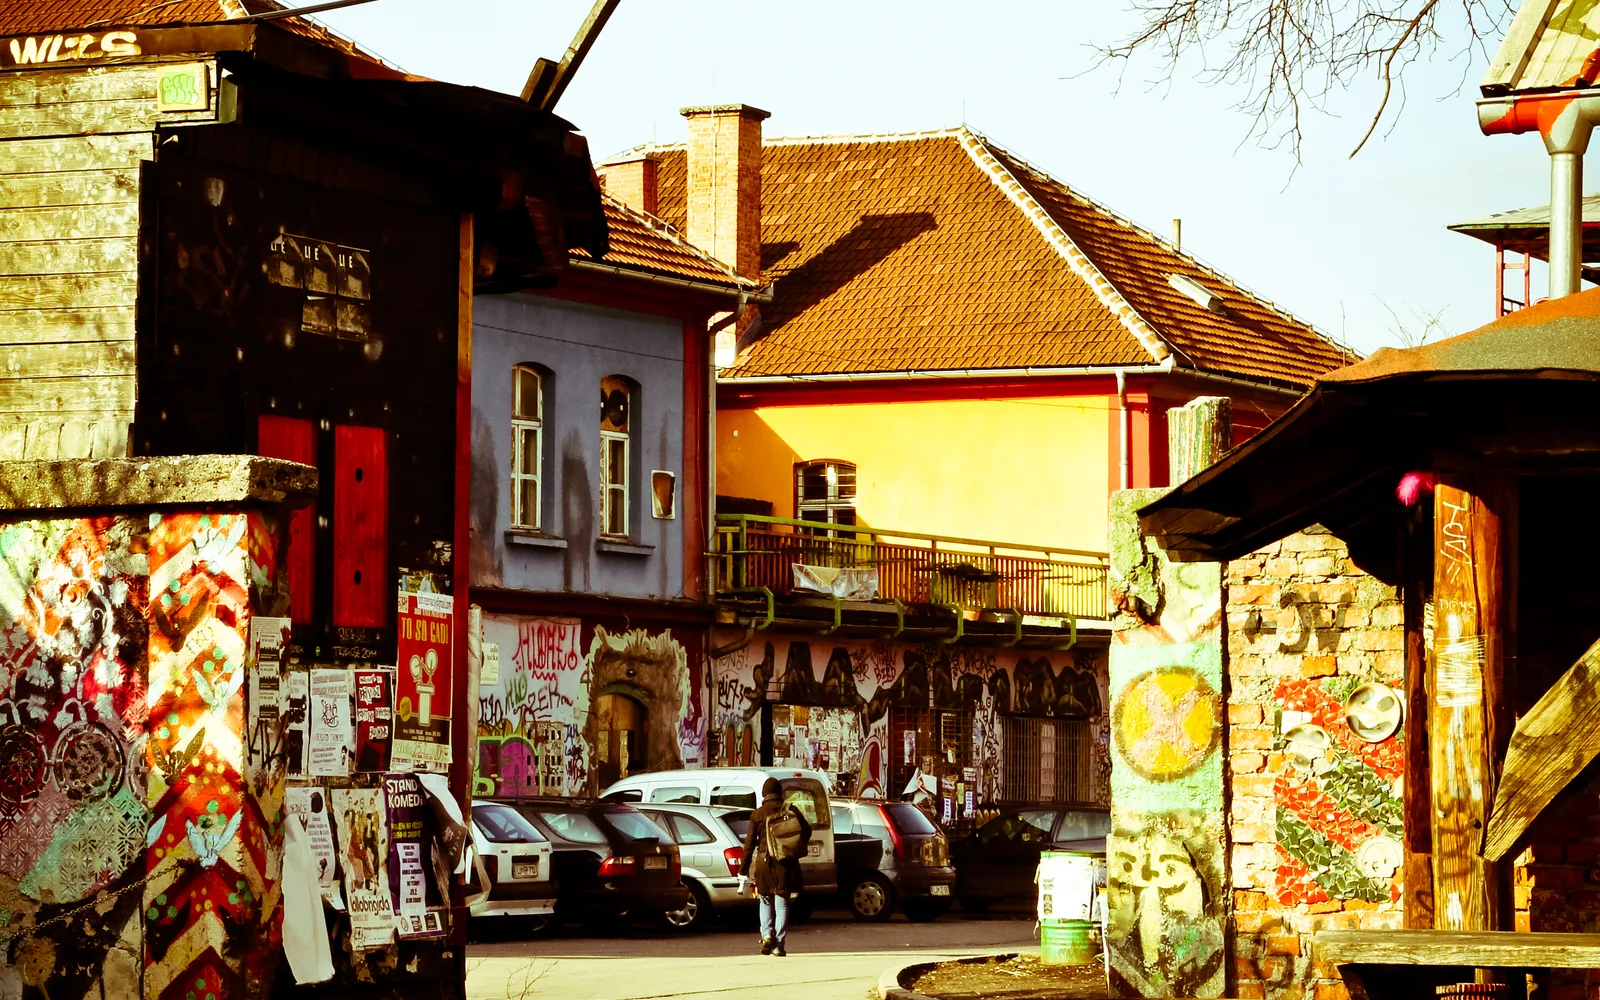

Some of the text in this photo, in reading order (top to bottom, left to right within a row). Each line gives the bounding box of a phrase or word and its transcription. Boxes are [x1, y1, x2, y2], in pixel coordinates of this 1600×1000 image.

[401, 617, 412, 639] TO
[415, 619, 427, 641] SO
[386, 778, 418, 793] STAND
[388, 793, 424, 808] KOMEDi
